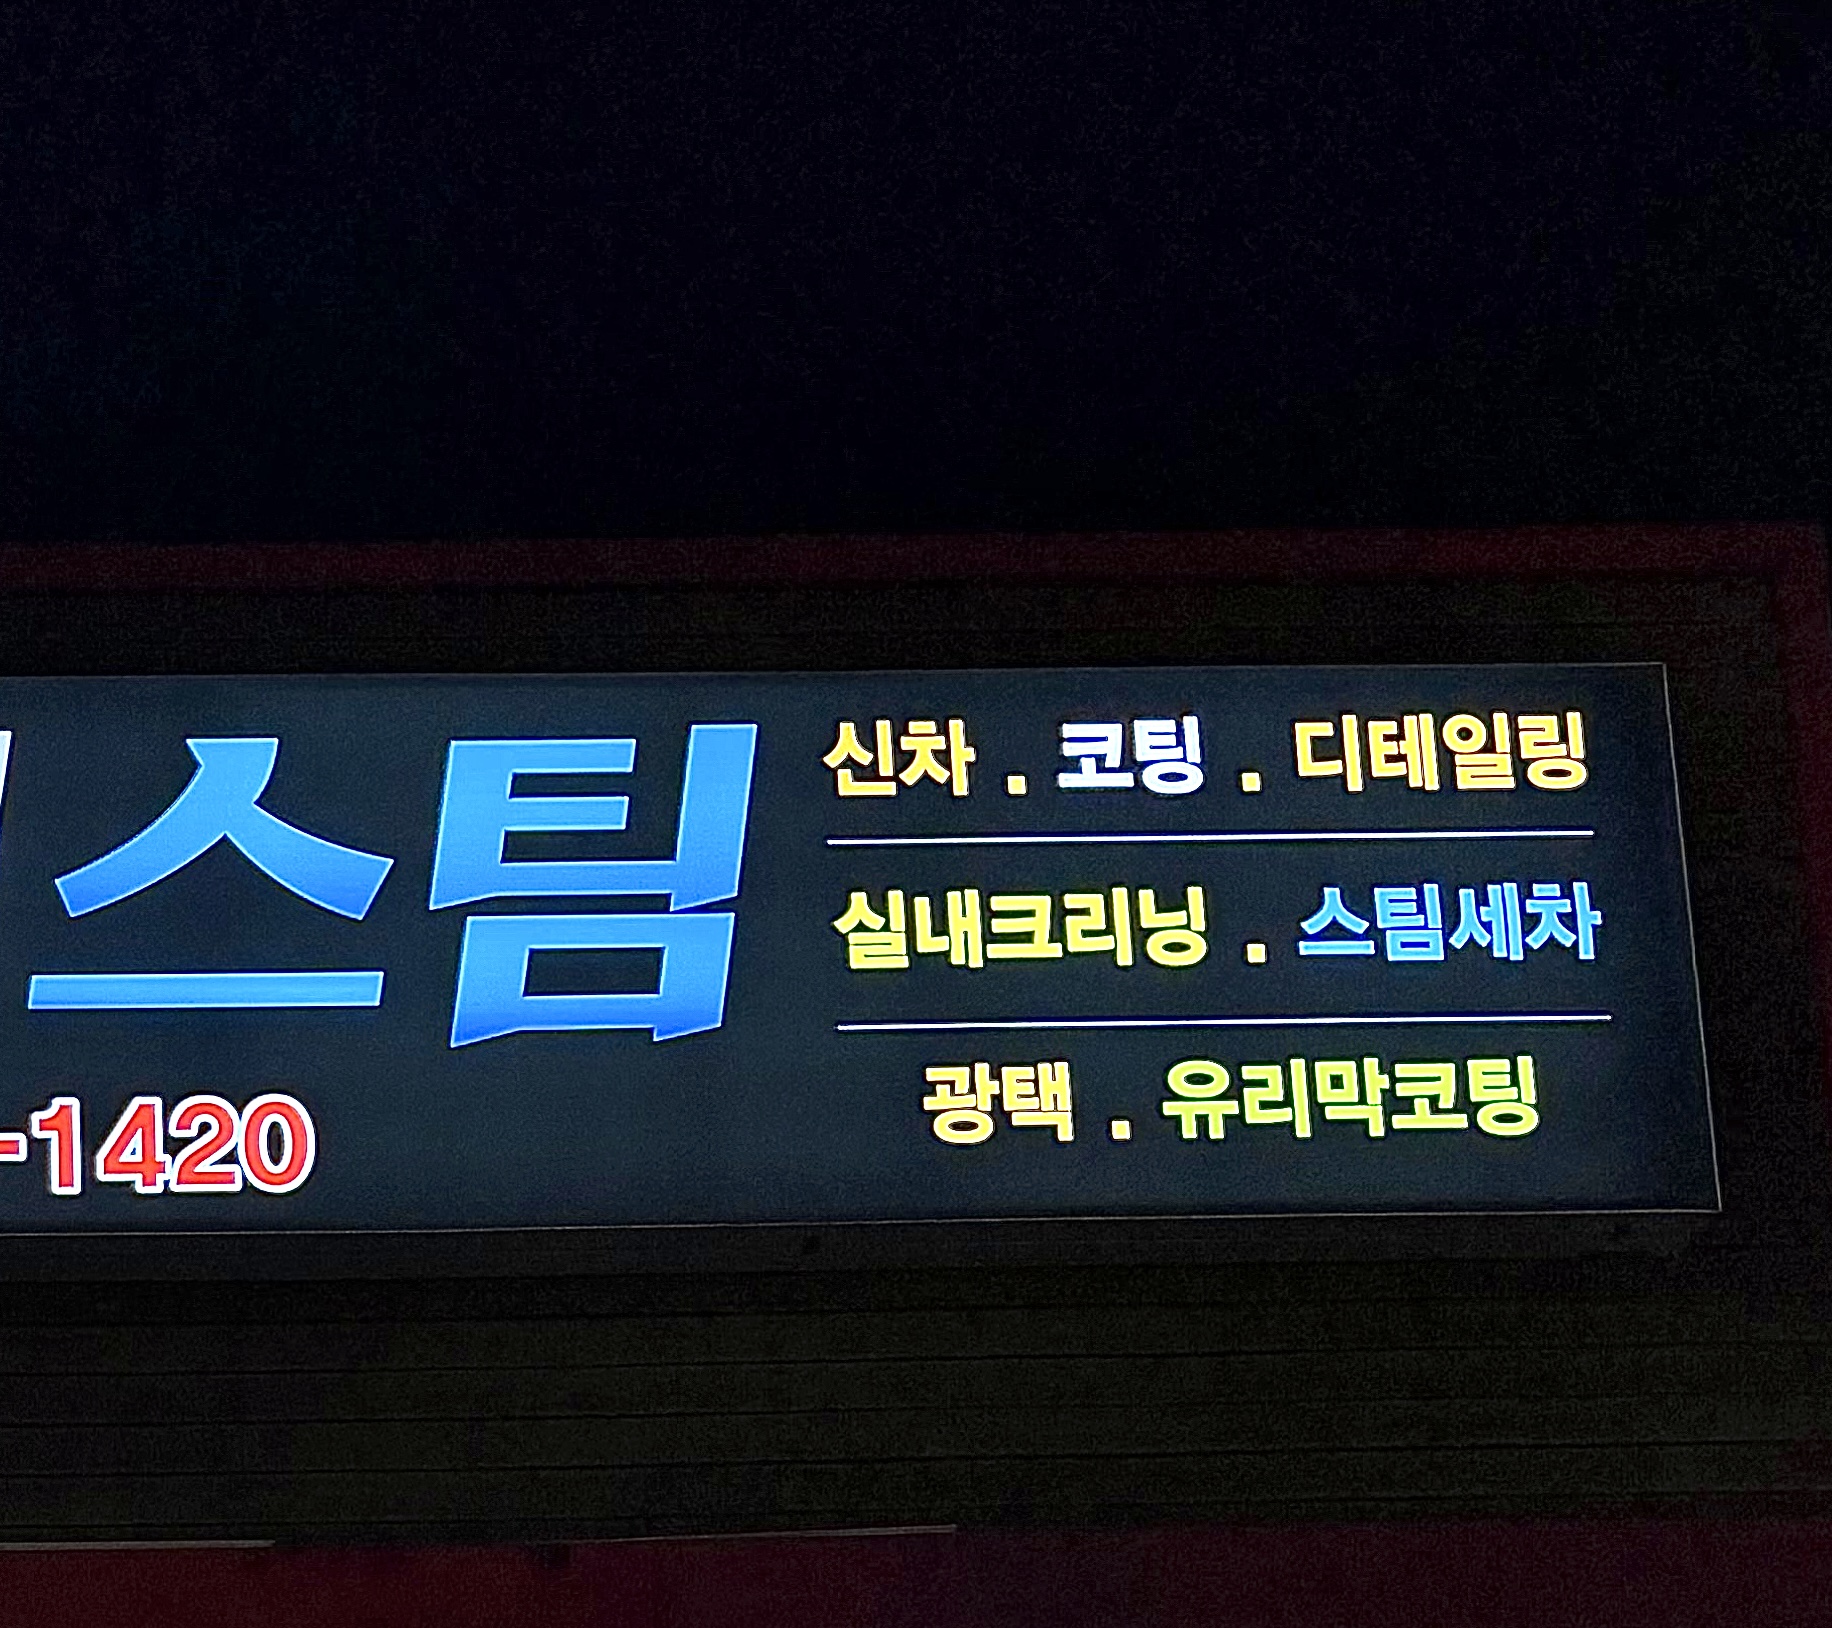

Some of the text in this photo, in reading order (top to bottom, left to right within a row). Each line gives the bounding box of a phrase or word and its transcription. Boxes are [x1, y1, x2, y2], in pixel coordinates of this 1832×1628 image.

[822, 719, 976, 799] 신차
[1057, 715, 1204, 796] 코팅
[1295, 711, 1590, 792] 디테일링
[832, 886, 1208, 970] 실내크리닝
[1297, 882, 1601, 962] 스팀세차
[923, 1061, 1074, 1143] 광택
[1162, 1056, 1541, 1138] 유리막코팅
